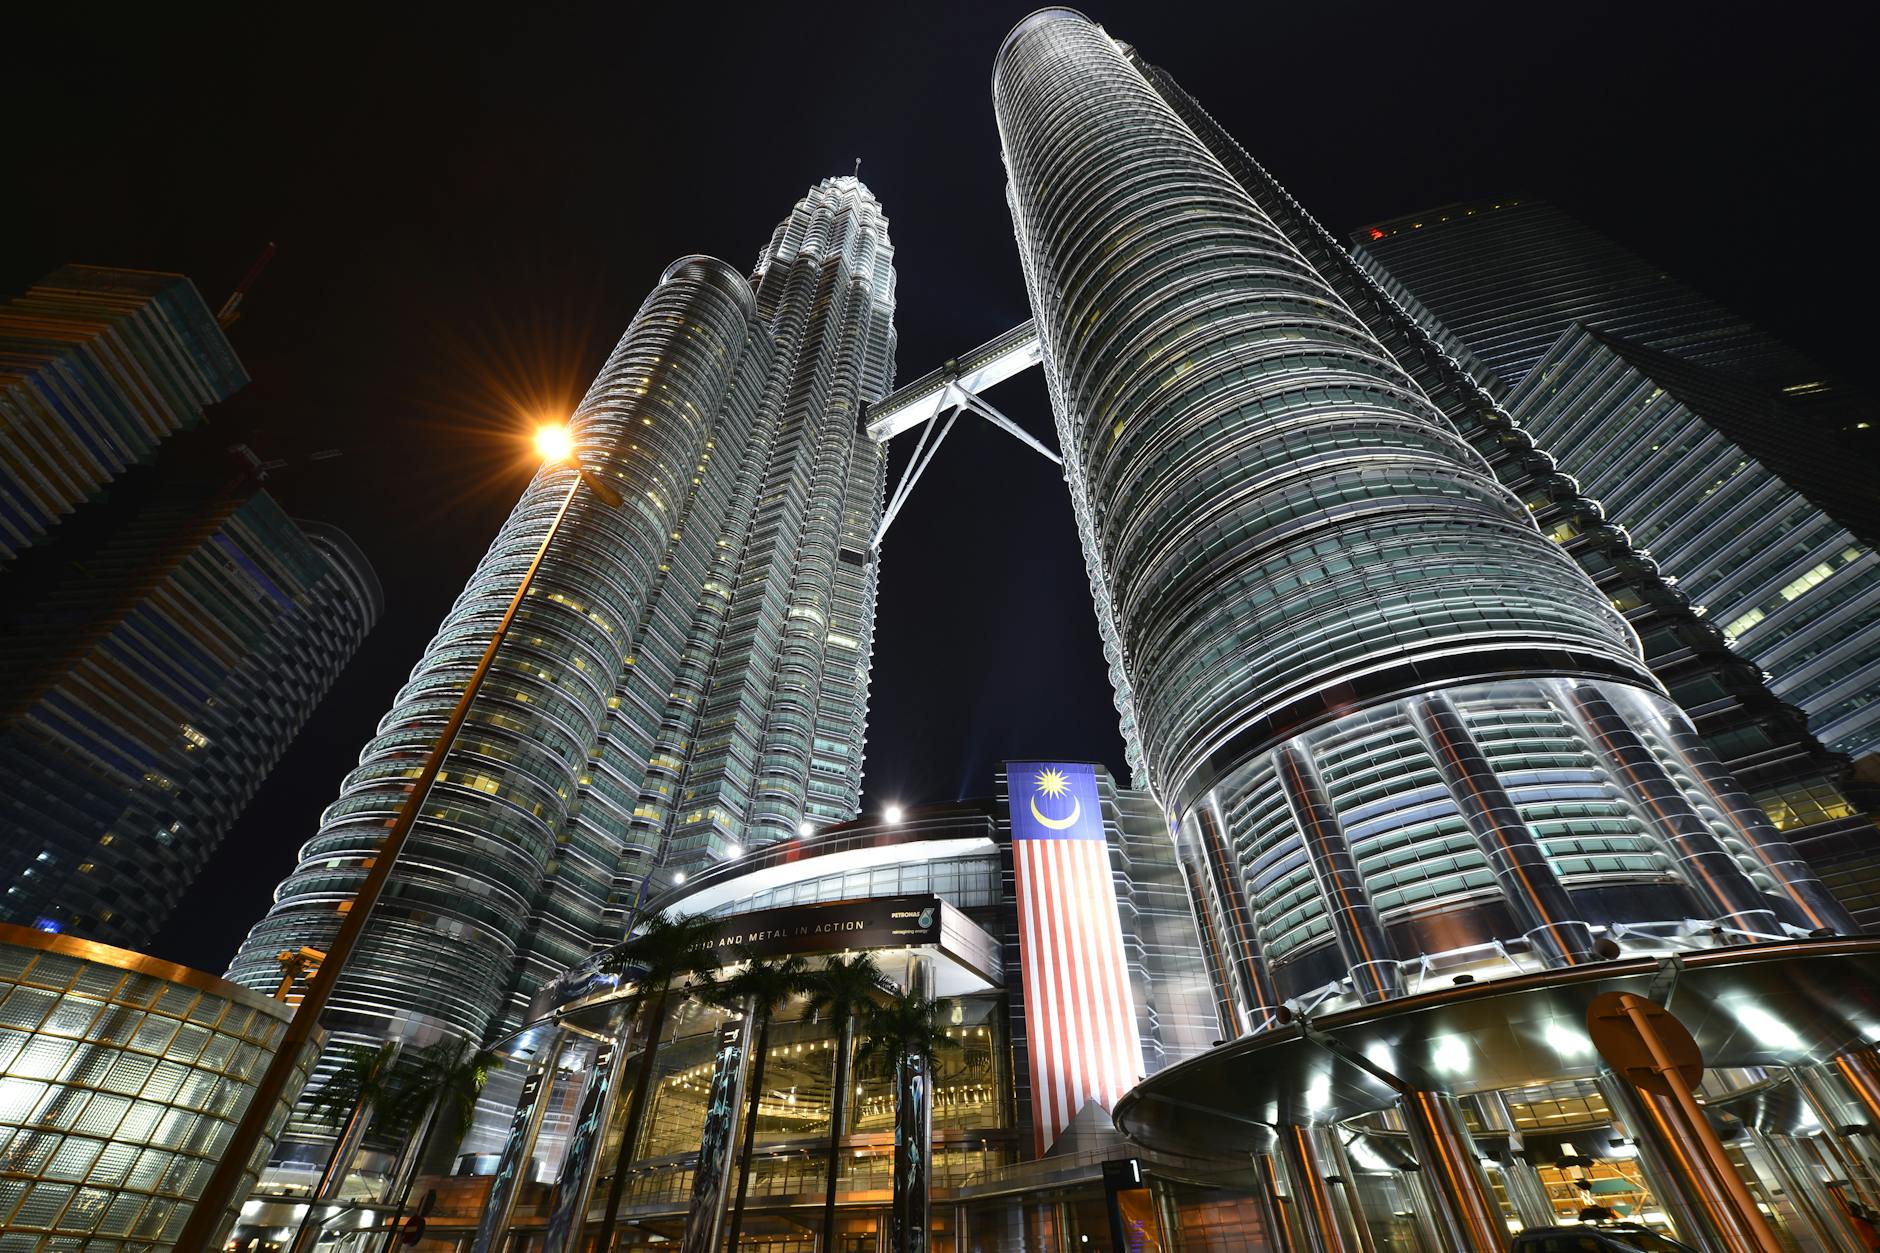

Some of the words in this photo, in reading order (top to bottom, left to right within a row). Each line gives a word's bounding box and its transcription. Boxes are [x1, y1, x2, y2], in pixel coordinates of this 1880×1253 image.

[718, 935, 742, 947] AND
[748, 930, 788, 942] METAL
[795, 926, 808, 935] IN
[815, 920, 864, 933] ACTION
[1130, 1159, 1140, 1182] 1
